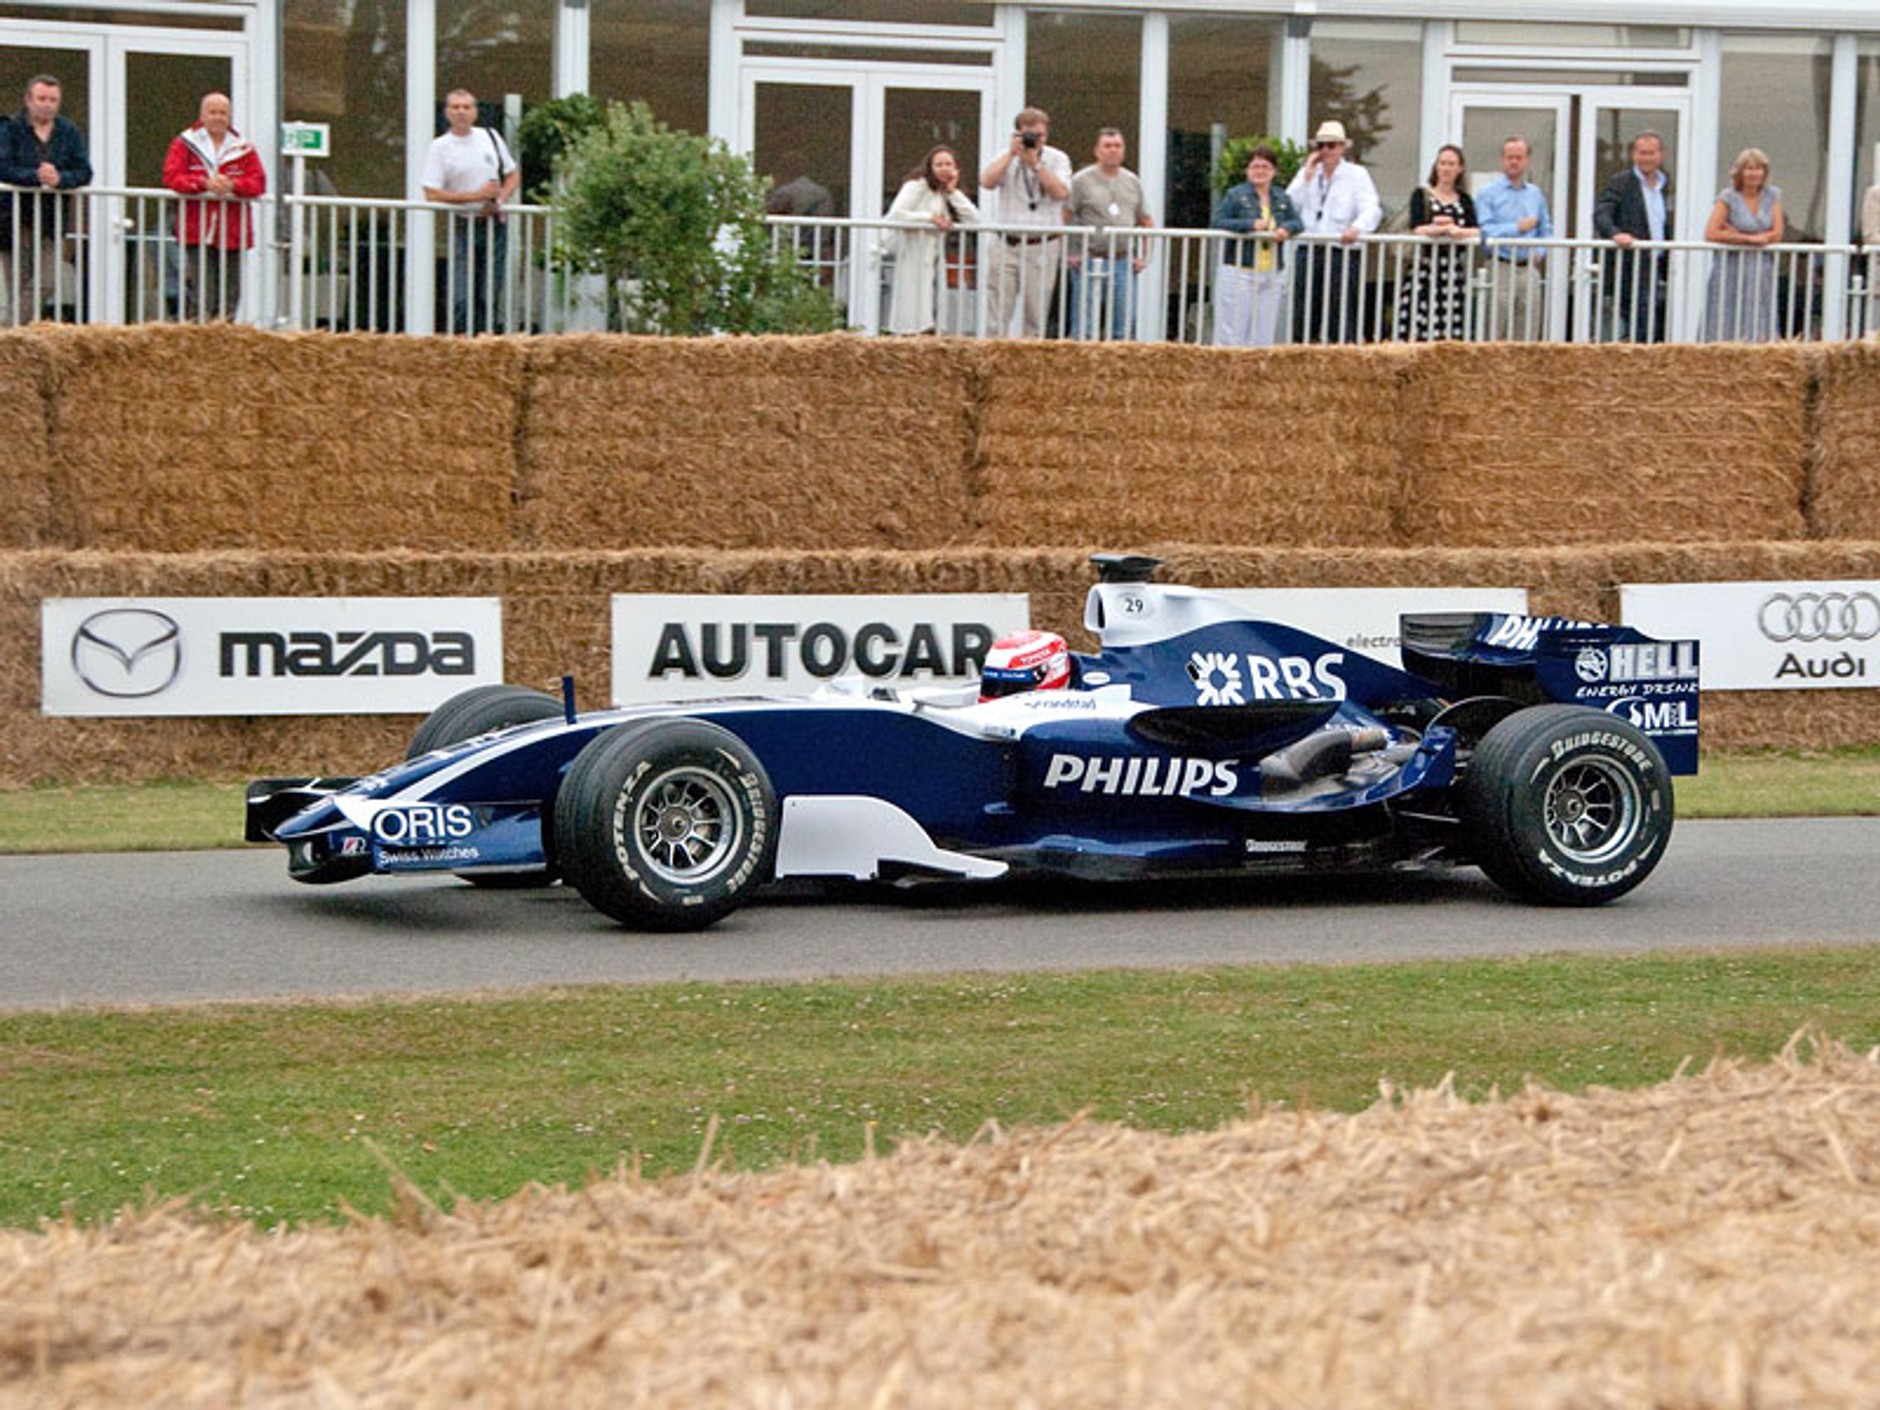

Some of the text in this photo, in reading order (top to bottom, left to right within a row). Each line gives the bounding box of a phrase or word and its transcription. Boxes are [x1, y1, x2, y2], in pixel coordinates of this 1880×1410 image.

[1125, 597, 1144, 613] 29
[648, 622, 995, 682] AUTOCAR
[1610, 641, 1699, 682] HELL
[1775, 651, 1865, 678] Audi
[1043, 753, 1240, 797] PHILIPS
[374, 805, 472, 841] ORIS
[613, 760, 652, 881] POTENZA
